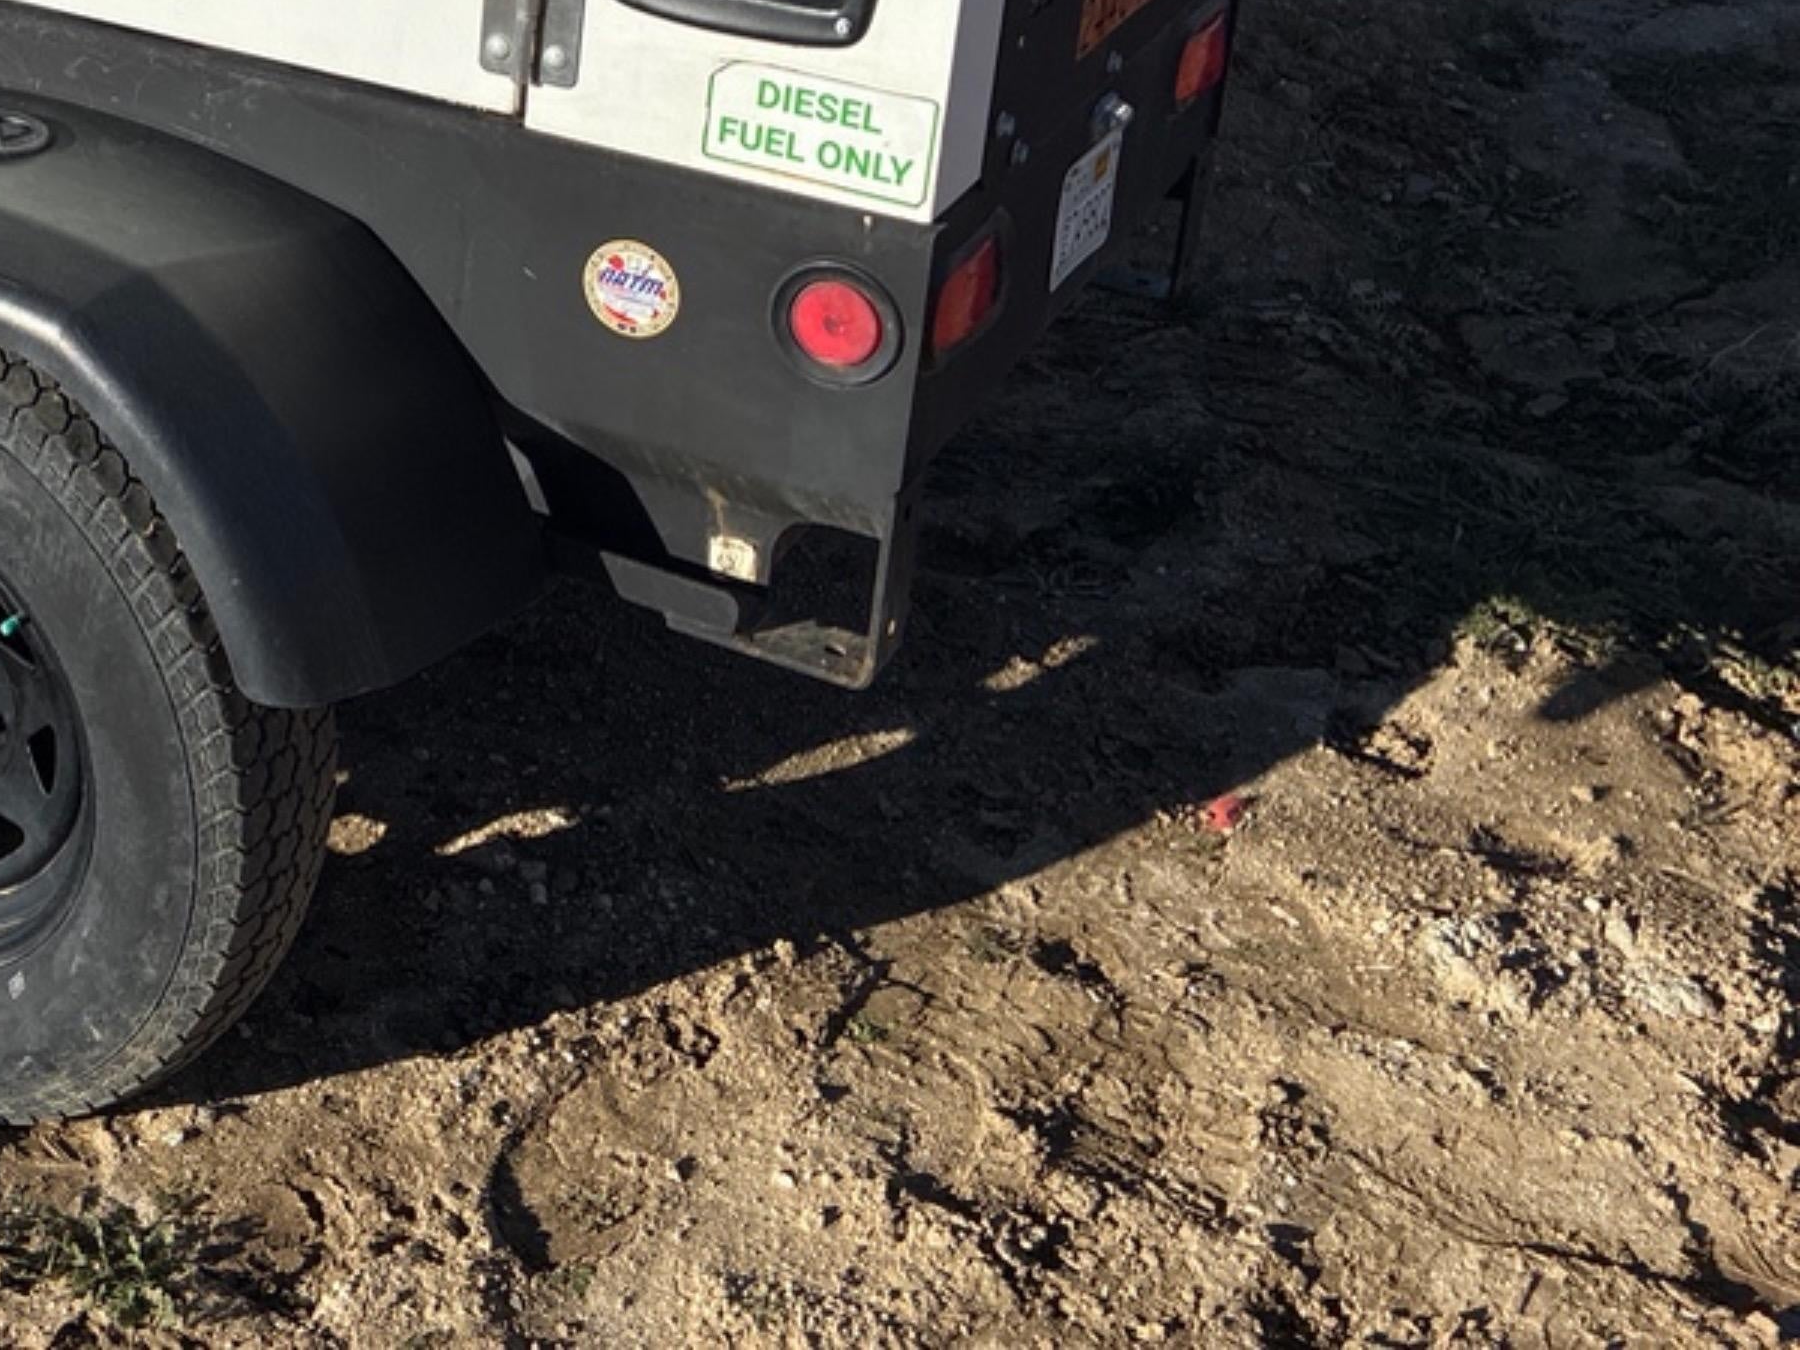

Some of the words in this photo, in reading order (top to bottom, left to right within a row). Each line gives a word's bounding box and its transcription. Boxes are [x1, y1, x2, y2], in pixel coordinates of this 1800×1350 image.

[756, 79, 883, 136] DIESEL
[718, 115, 806, 163] FUEL
[816, 139, 914, 186] ONLY
